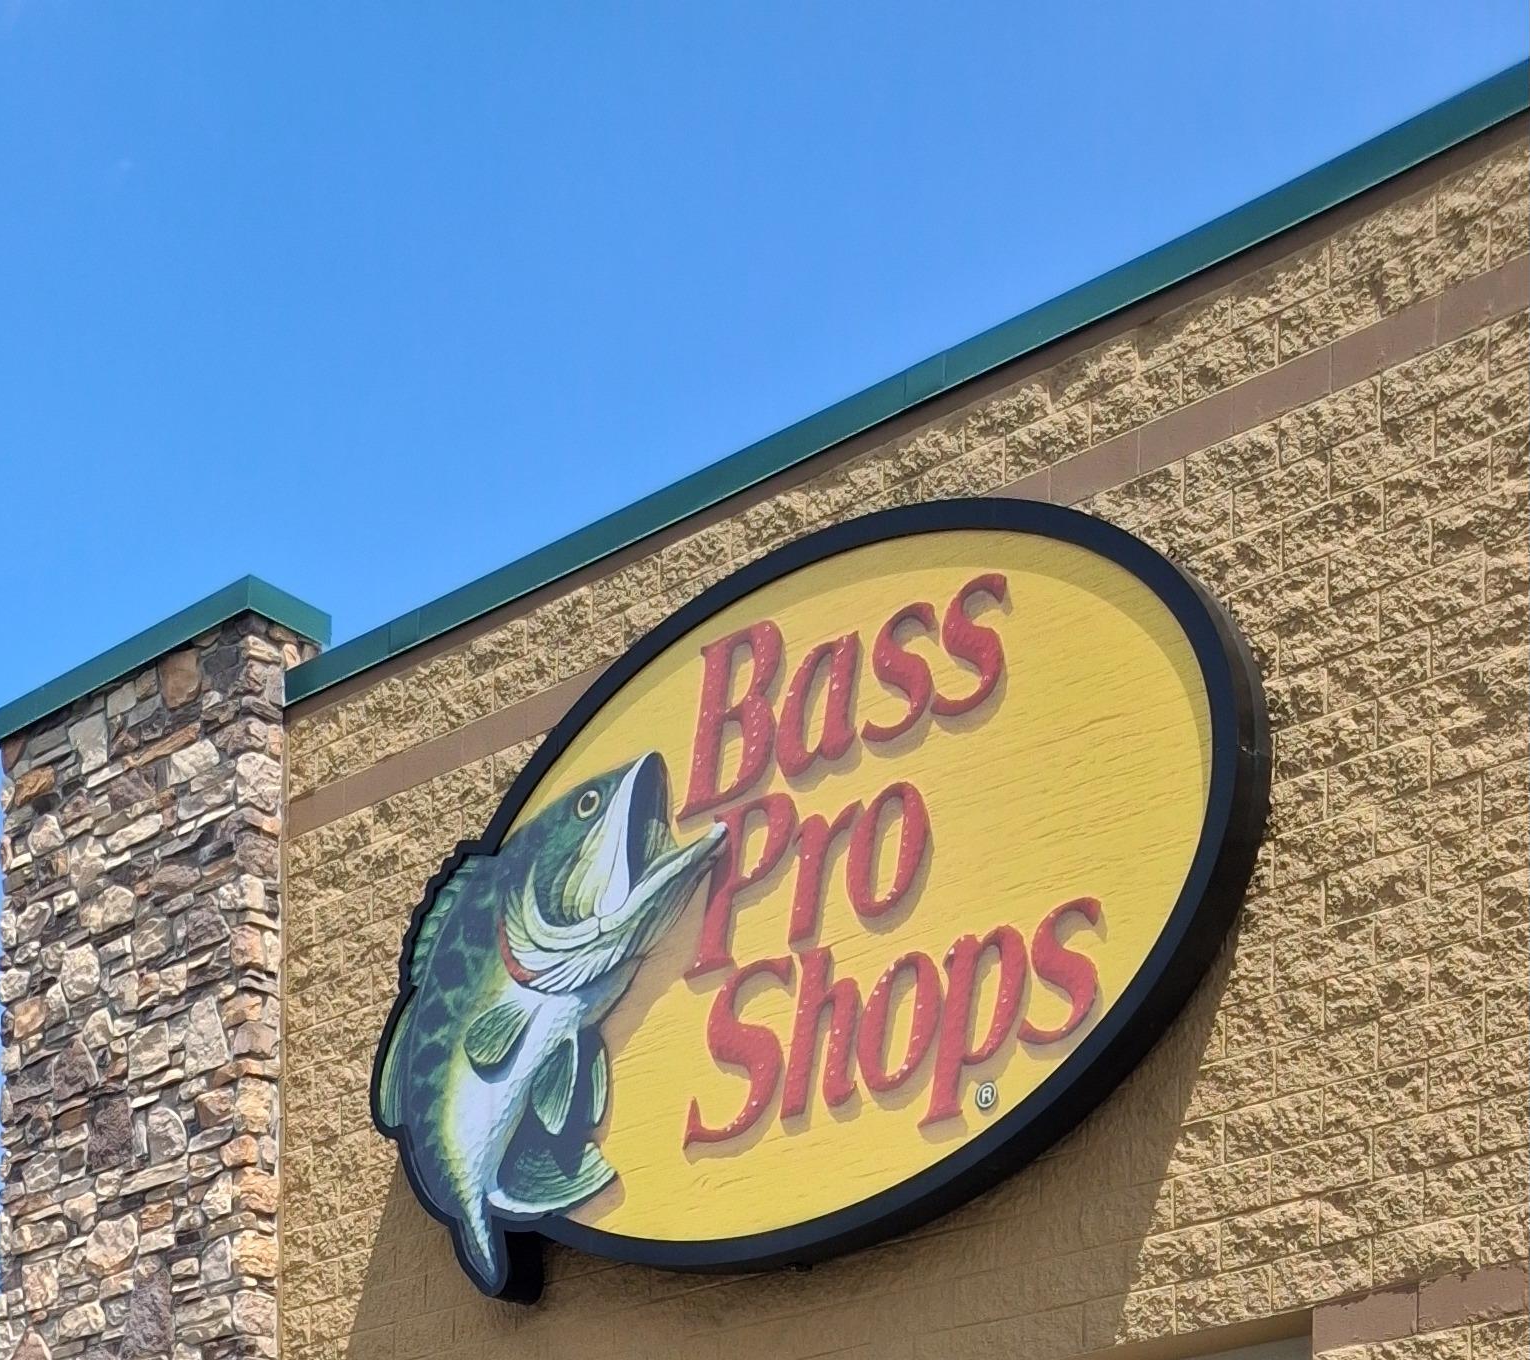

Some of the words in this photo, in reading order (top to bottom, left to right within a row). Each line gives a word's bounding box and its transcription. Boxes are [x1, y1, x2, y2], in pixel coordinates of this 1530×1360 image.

[676, 571, 1008, 823] Bass
[682, 780, 928, 981] Pro
[683, 896, 1102, 1150] Shops
